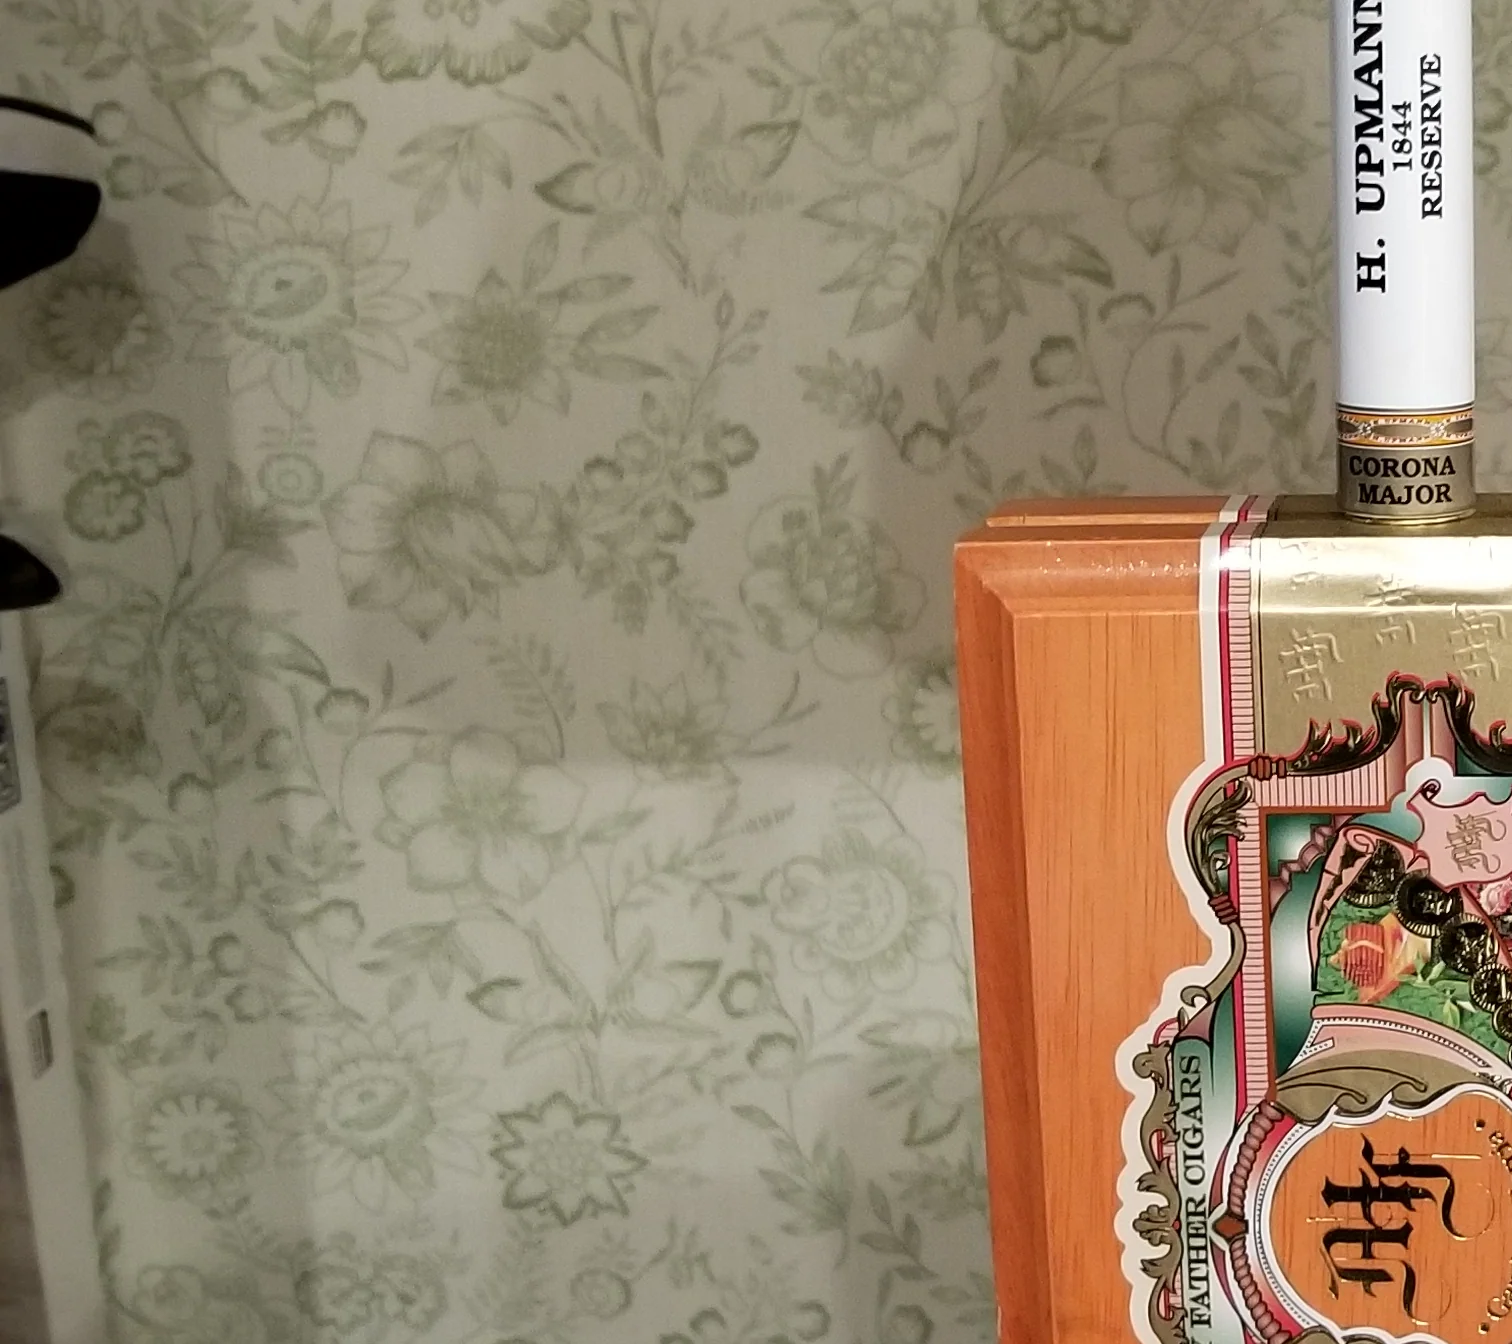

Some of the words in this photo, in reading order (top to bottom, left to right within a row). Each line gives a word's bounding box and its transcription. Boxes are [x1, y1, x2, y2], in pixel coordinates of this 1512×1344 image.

[1391, 101, 1412, 171] 1844
[1420, 53, 1443, 220] RESERVE
[1356, 238, 1386, 293] H.
[1350, 455, 1456, 478] CORONA
[1358, 483, 1453, 505] MAJOR
[1179, 1055, 1206, 1187] CIGARS
[1188, 1193, 1213, 1329] FATHER
